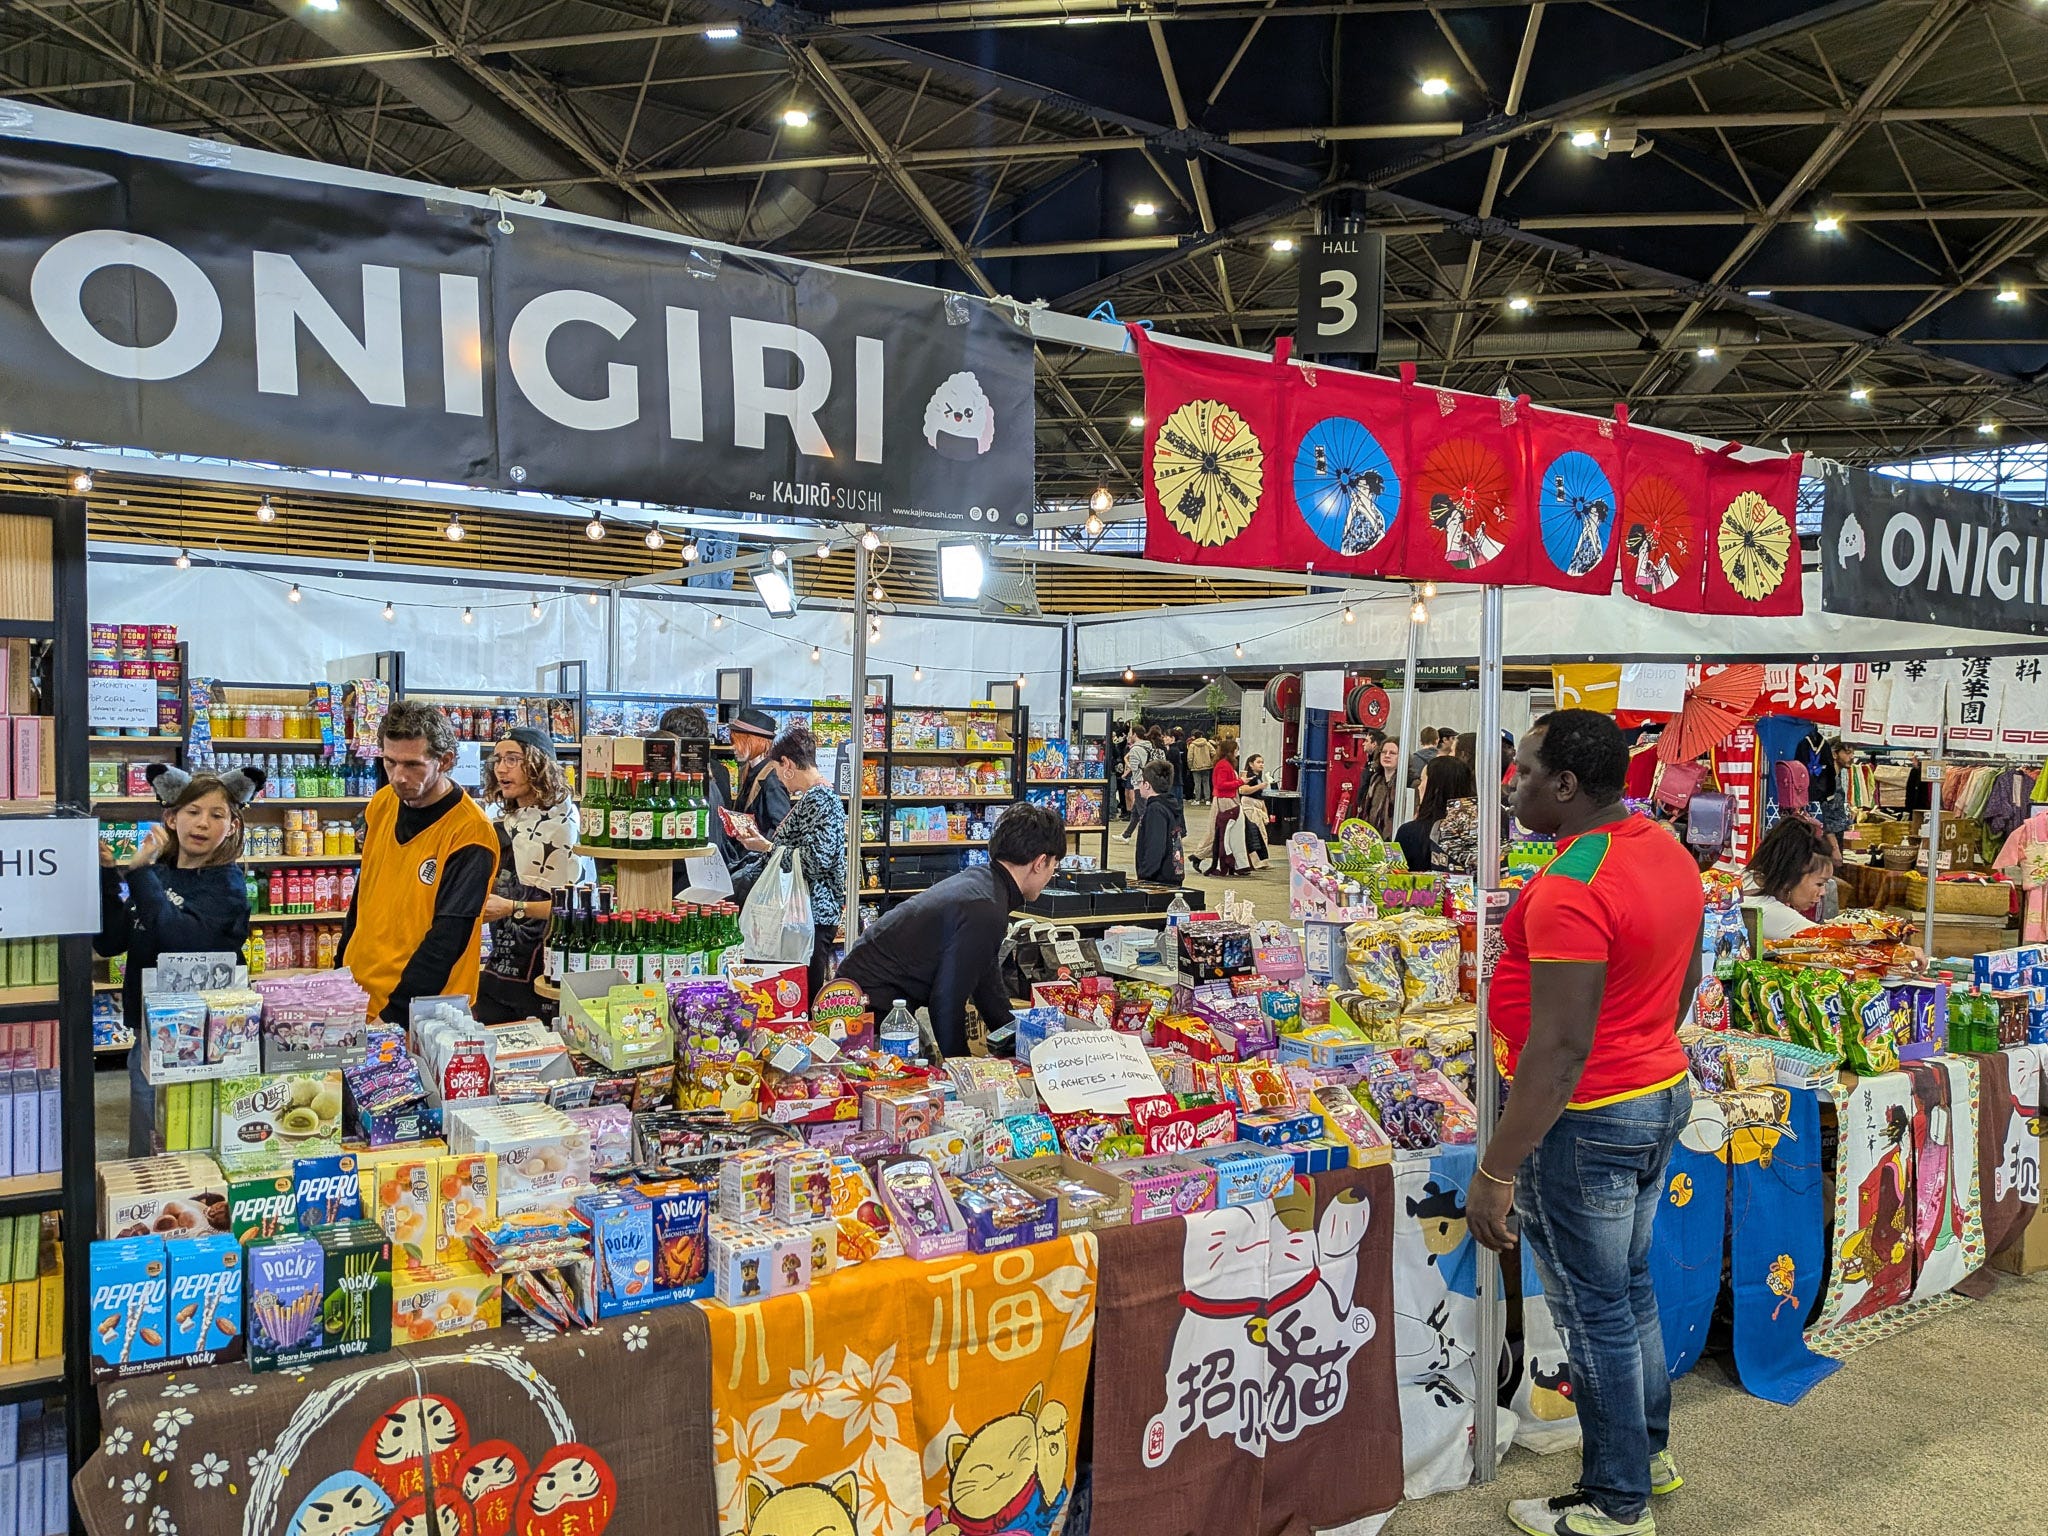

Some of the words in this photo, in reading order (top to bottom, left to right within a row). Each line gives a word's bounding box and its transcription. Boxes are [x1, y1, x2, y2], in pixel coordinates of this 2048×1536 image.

[1322, 240, 1359, 254] HALL
[1317, 269, 1358, 336] 3
[30, 230, 884, 464] ONIGIRI
[750, 491, 766, 502] Par
[893, 506, 964, 520] www.kajirosushi.com
[1945, 823, 1957, 840] CB
[1956, 843, 1969, 864] 15
[1053, 1035, 1114, 1049] PROMOTION
[1048, 1078, 1058, 1091] 2
[296, 1174, 359, 1204] PEPERO
[232, 1193, 297, 1223] PEPERO
[171, 1269, 241, 1300] PEPERO
[92, 1279, 166, 1312] PEPERO
[277, 1353, 299, 1363] Share
[300, 1345, 338, 1359] happiness!
[119, 1363, 142, 1374] Share
[143, 1358, 184, 1370] happiness!
